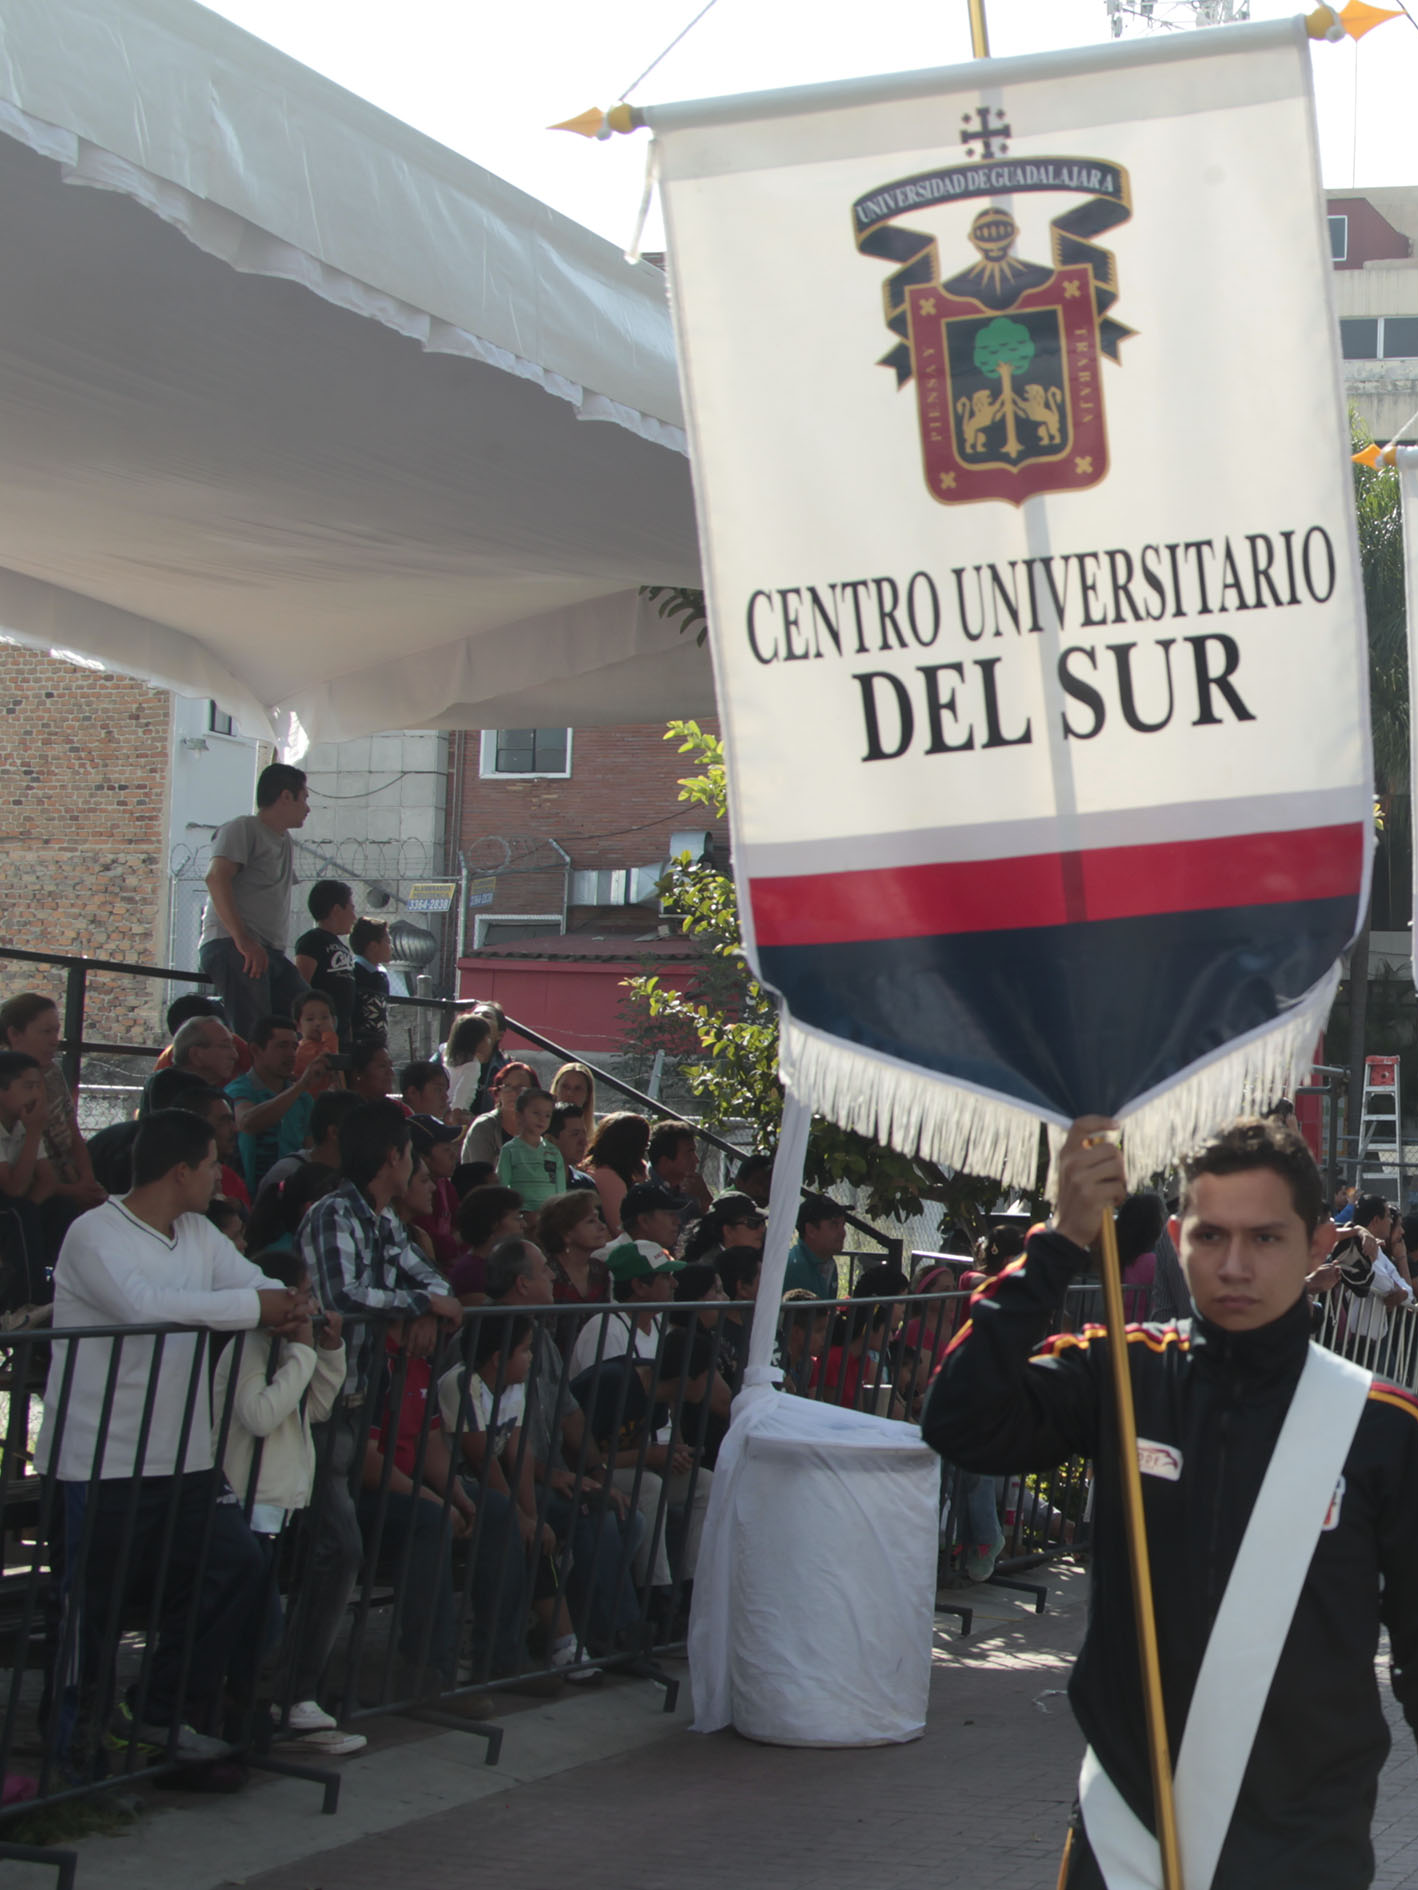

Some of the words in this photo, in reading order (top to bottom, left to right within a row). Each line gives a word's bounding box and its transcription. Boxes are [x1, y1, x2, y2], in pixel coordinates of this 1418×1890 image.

[856, 172, 967, 223] UNIVERSIDAD
[967, 171, 990, 190] DE
[991, 164, 1114, 193] GUADALAJARA
[1074, 328, 1095, 423] TRABAJA
[746, 570, 941, 665] CENTRO
[951, 525, 1337, 642] UNIVERSITARIO
[852, 656, 1033, 763] DEL
[1056, 632, 1257, 741] SUR
